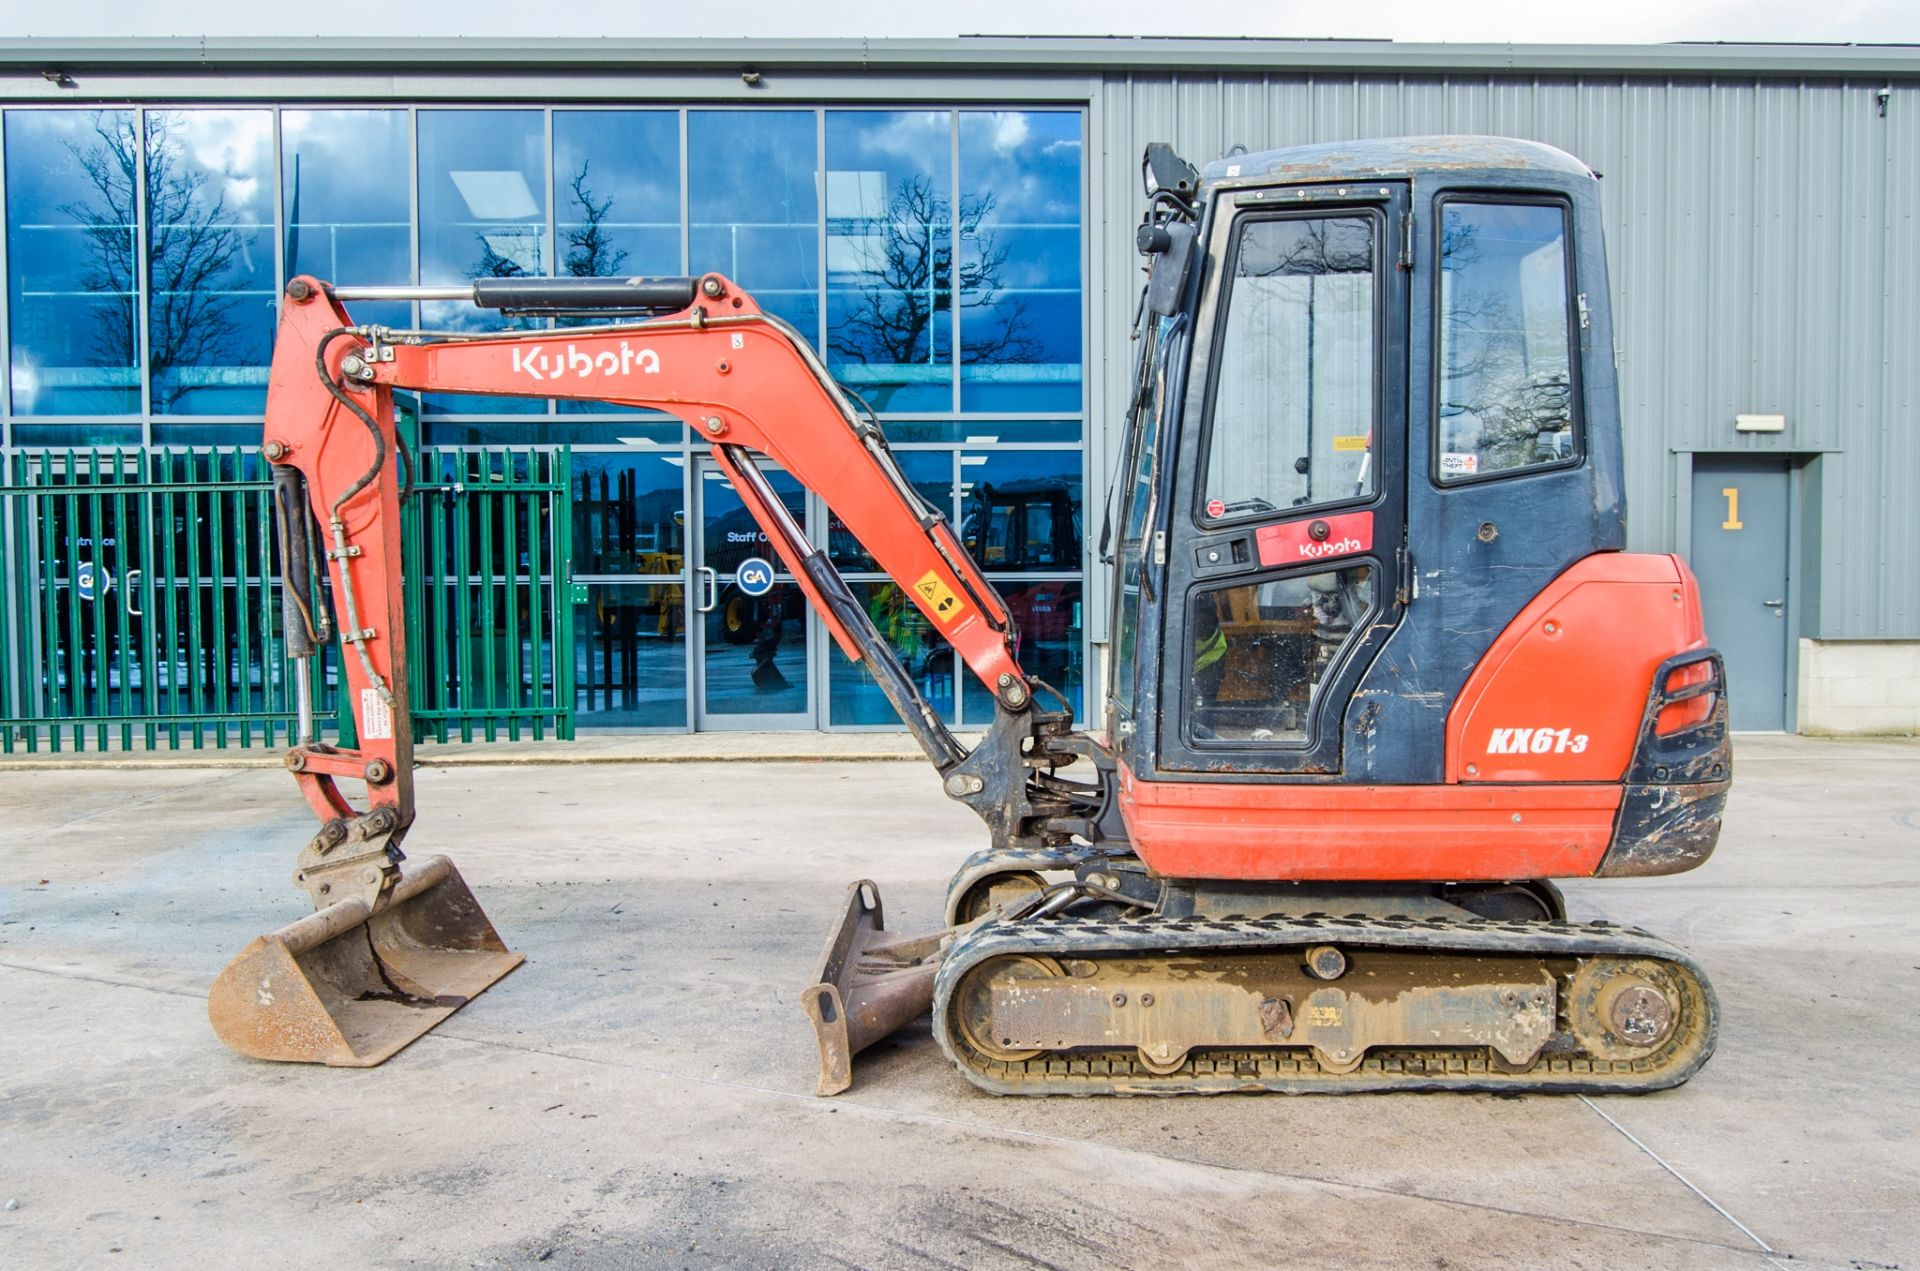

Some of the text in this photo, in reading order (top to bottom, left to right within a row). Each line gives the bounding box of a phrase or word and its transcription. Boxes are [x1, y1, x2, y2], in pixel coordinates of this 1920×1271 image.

[512, 341, 661, 380] Kubota
[1722, 487, 1744, 530] 1
[727, 532, 757, 542] Staff
[1299, 538, 1361, 557] Kubota
[743, 570, 768, 584] GA
[1486, 727, 1590, 755] KX61-3
